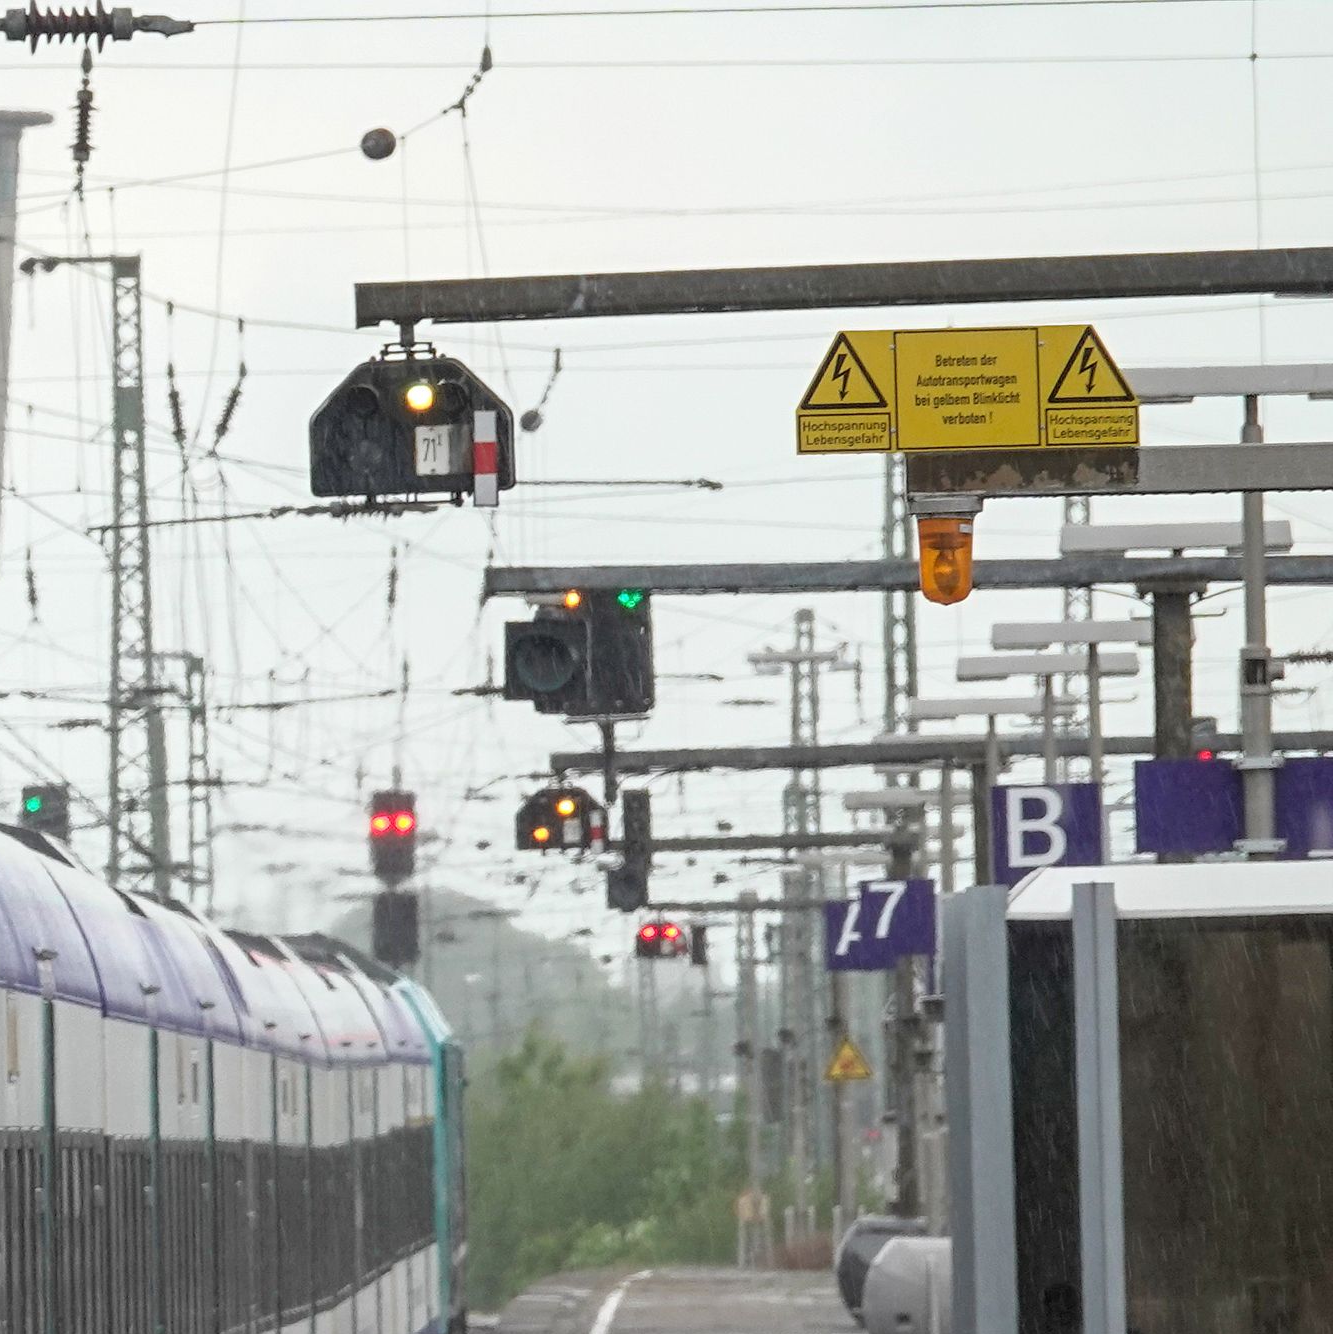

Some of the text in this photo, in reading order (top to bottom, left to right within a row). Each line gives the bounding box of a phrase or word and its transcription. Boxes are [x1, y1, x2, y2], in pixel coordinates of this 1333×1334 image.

[935, 353, 998, 368] Betreten der
[916, 374, 1018, 388] Autotransportwagen
[915, 393, 931, 407] bei
[933, 393, 971, 409] gelbem
[942, 411, 987, 425] verboten
[1049, 413, 1134, 427] Hochspannung
[802, 420, 887, 433] Hochspannung
[1053, 426, 1131, 440] Lebensgefahr
[806, 433, 884, 447] Lebensgefahr
[1005, 786, 1068, 869] B
